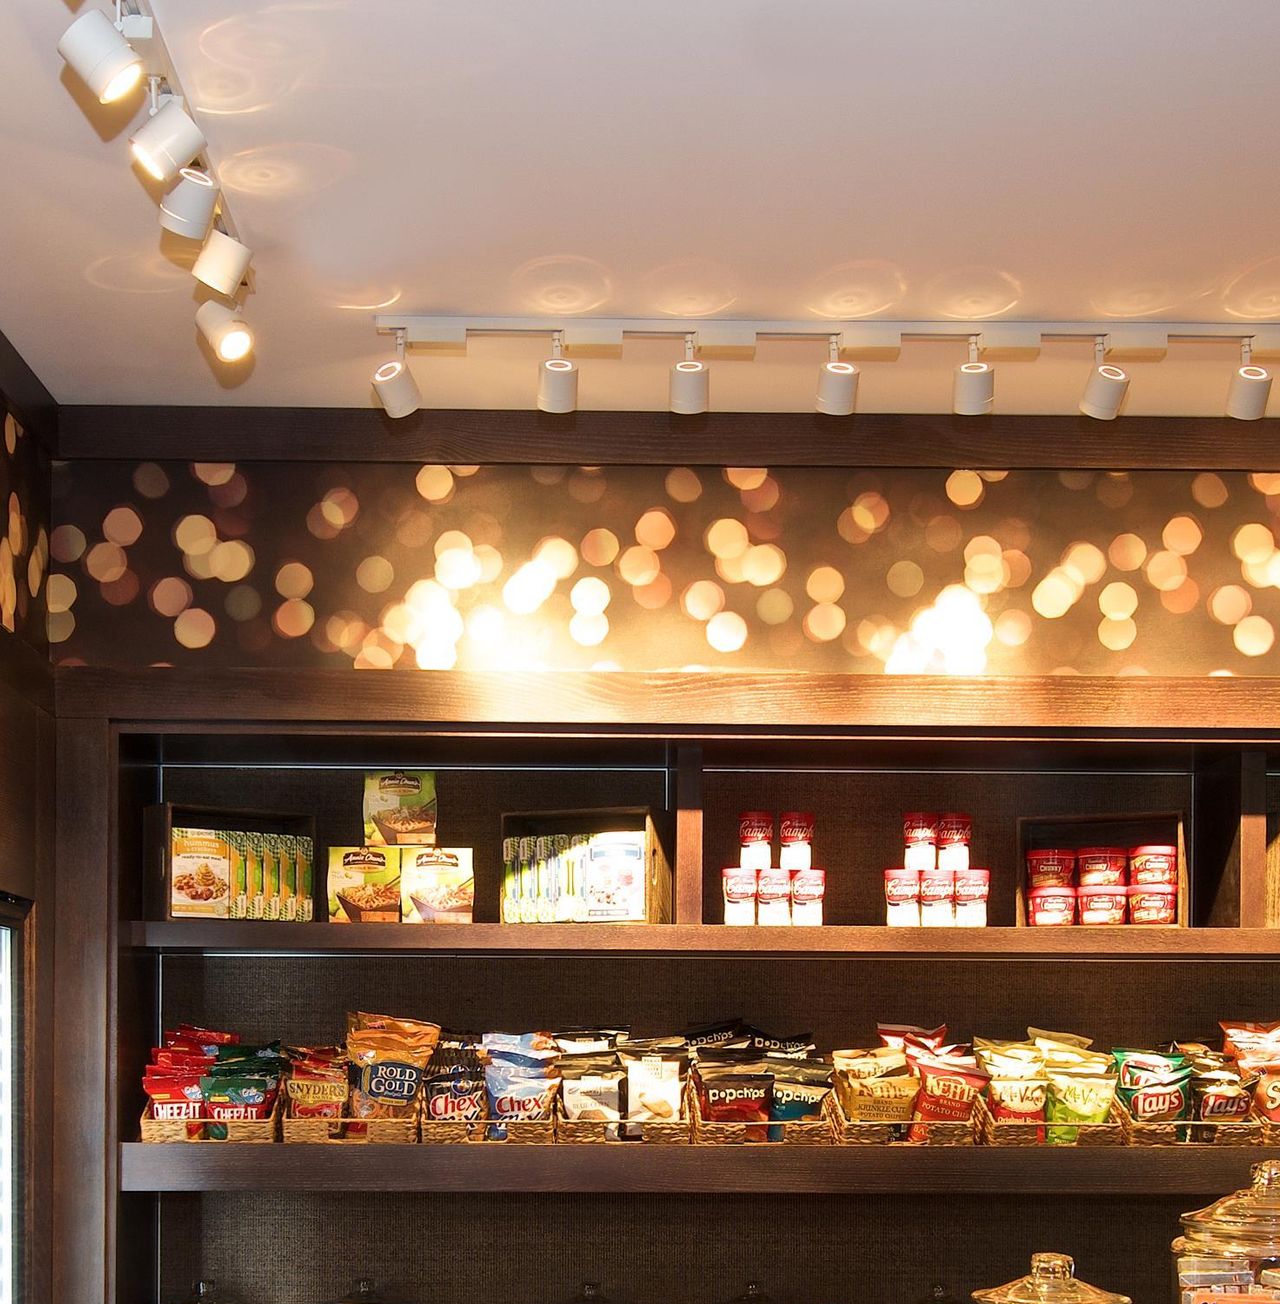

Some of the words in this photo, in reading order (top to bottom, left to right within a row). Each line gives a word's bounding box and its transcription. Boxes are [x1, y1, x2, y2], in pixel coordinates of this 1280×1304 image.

[184, 840, 219, 849] hummus
[376, 1066, 416, 1081] ROLD
[289, 1080, 346, 1097] SNYDER'S
[371, 1077, 417, 1096] GOLD
[709, 1088, 766, 1102] popchips
[926, 1073, 979, 1103] KETTLE
[154, 1102, 201, 1119] CHEEZ-IT
[430, 1091, 482, 1117] Chex
[496, 1091, 545, 1115] Chex
[922, 1102, 951, 1115] POTATO
